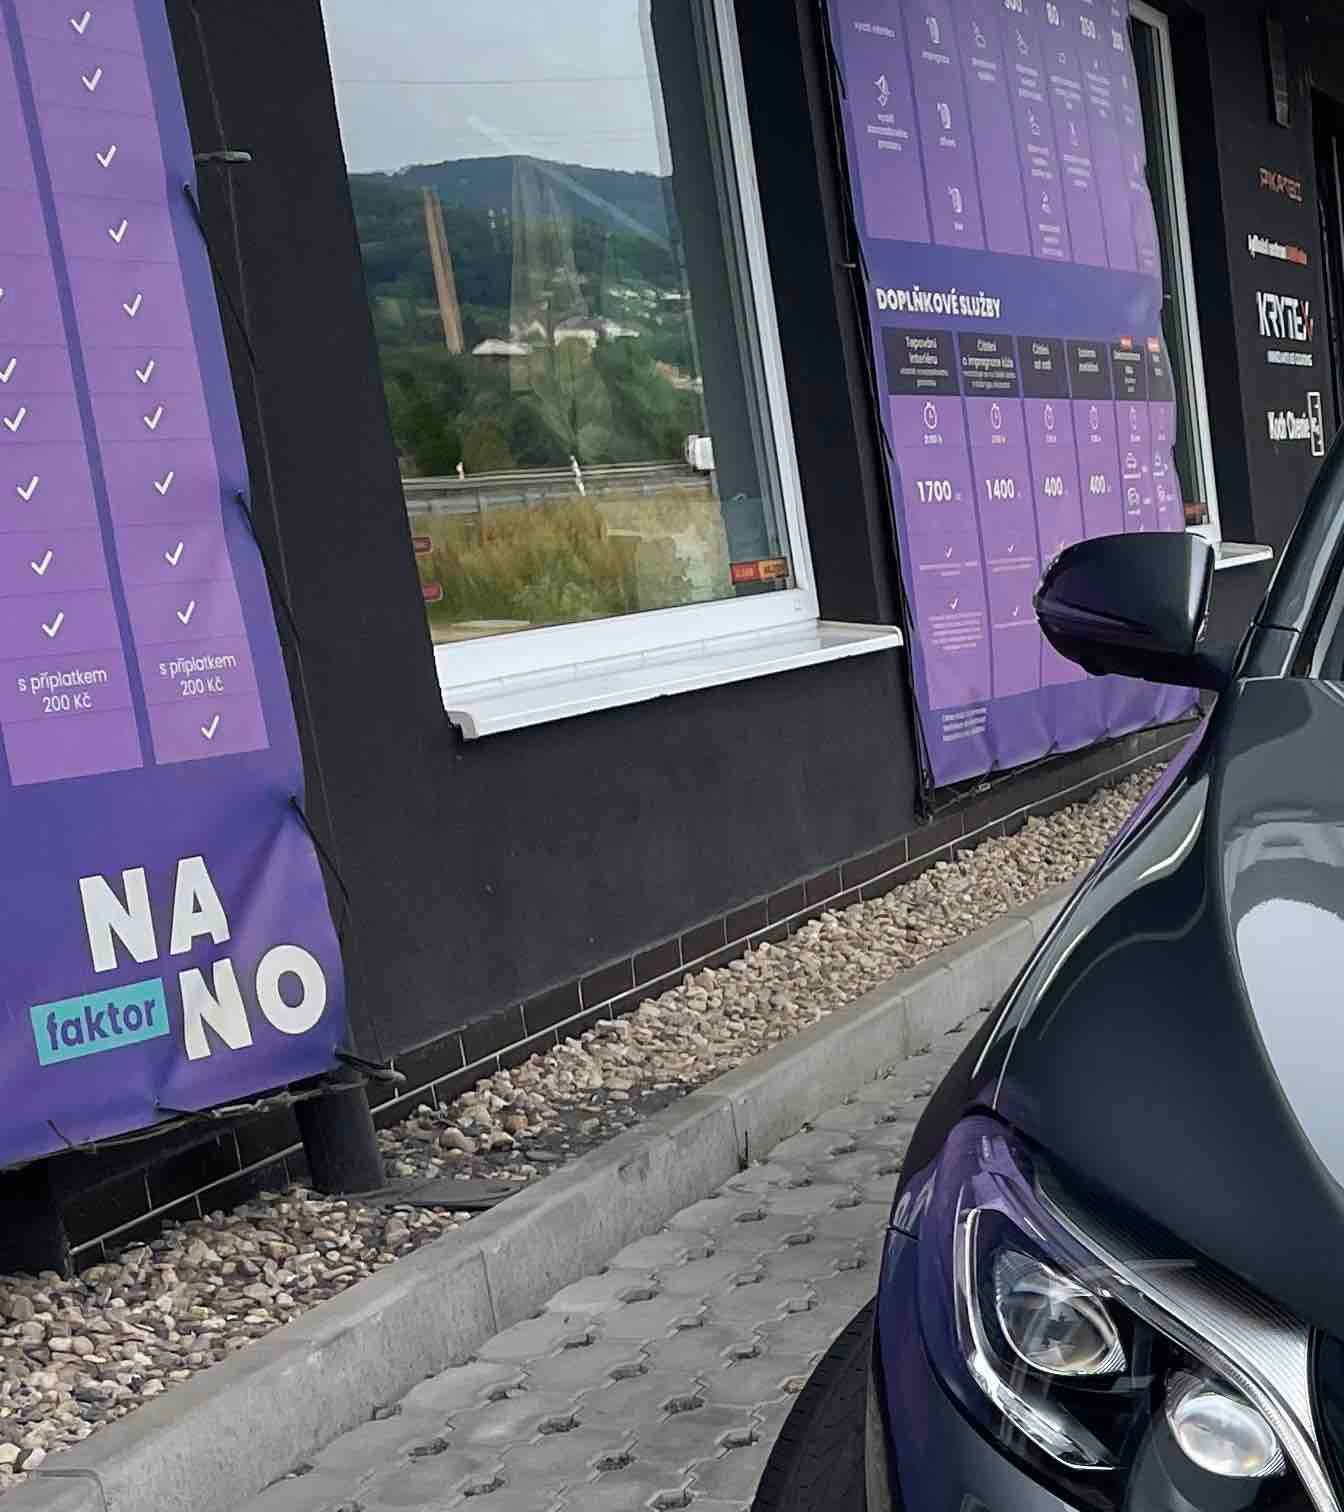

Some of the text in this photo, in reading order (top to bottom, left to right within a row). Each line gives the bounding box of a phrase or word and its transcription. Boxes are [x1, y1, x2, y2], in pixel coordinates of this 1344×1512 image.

[876, 284, 1000, 318] DOPLŇKOVÉ SLUŽBY
[917, 480, 951, 502] 1700
[985, 478, 1015, 500] 1400
[1044, 476, 1063, 496] 400
[1089, 475, 1106, 495] 400
[159, 655, 238, 679] s příplatkem
[17, 667, 108, 695] s příplatkem
[180, 676, 225, 697] 200 Kč
[42, 692, 92, 713] 200 Kč
[79, 856, 231, 973] NA
[46, 945, 327, 1061] faktor NO
